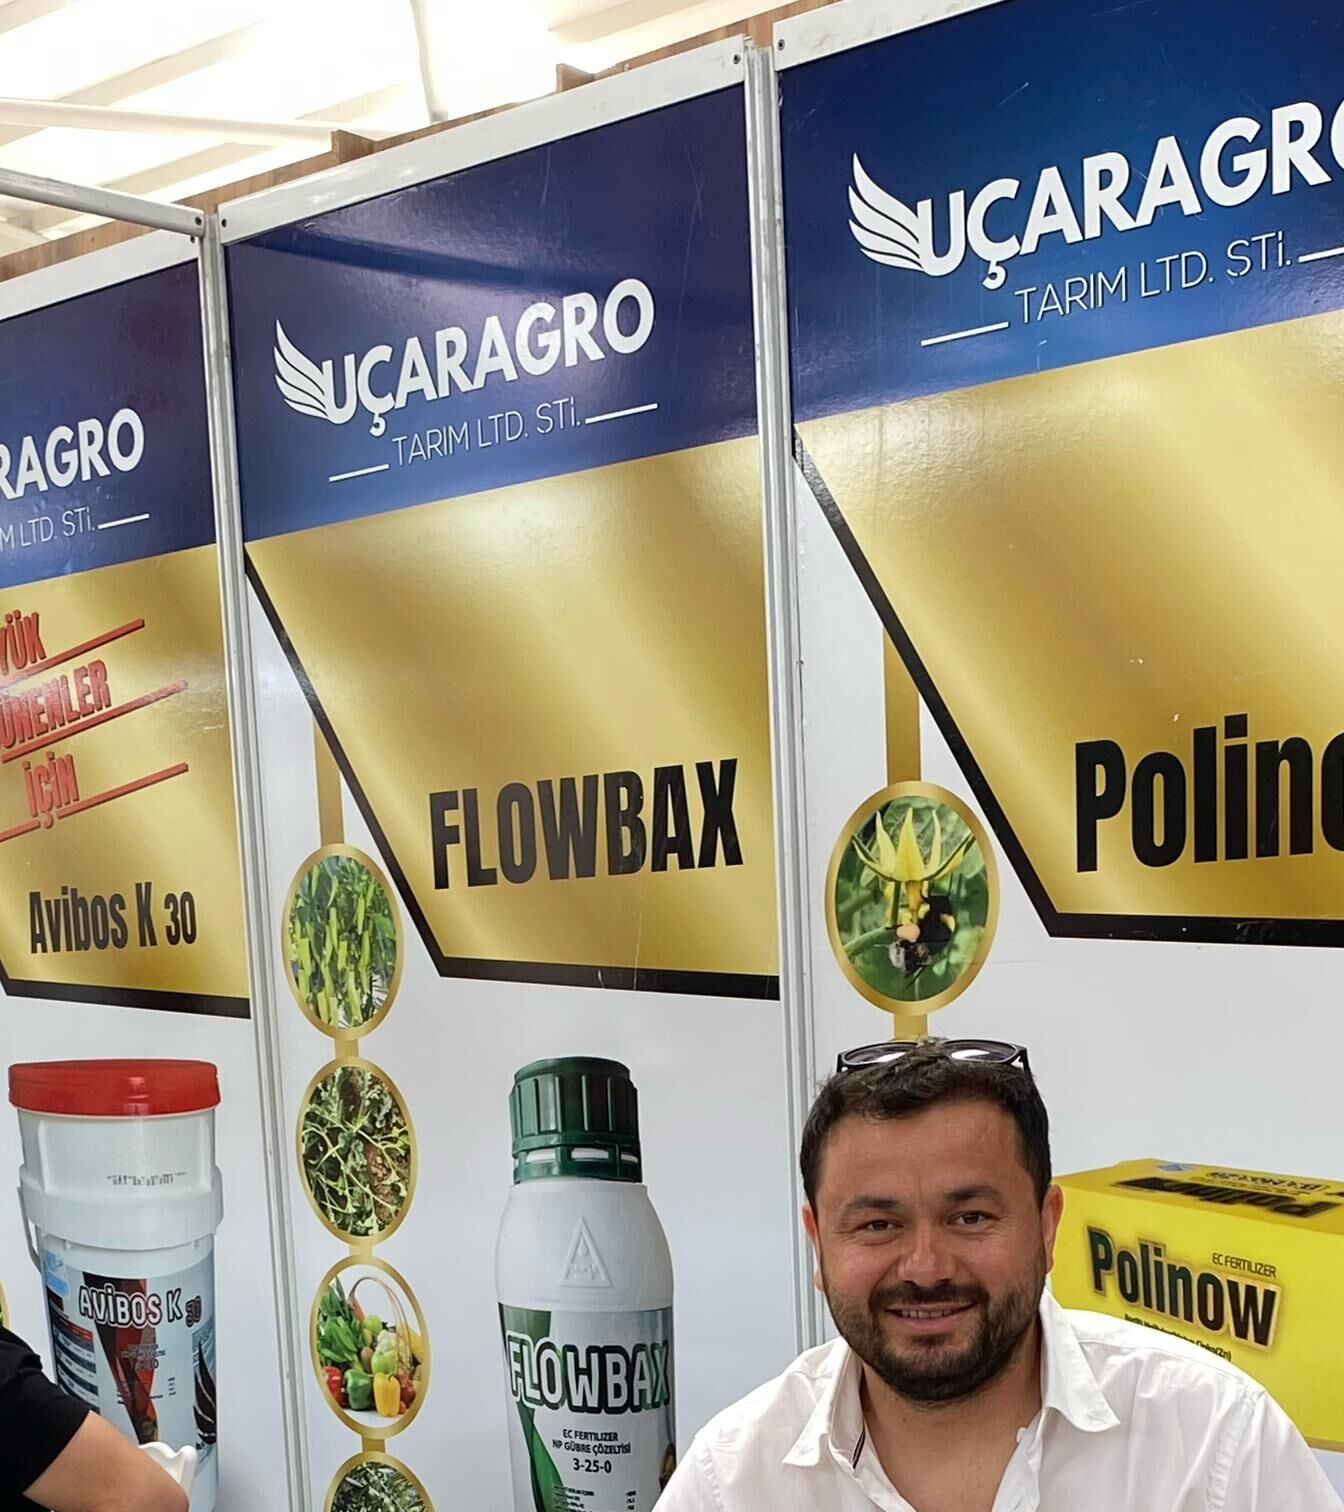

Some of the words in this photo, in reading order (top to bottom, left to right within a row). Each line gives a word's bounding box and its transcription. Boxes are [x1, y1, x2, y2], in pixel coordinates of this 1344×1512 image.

[1016, 270, 1129, 326] TARIM
[1140, 247, 1215, 303] LTD.
[320, 279, 655, 436] UÇARAGRO
[392, 424, 470, 467] TARIM
[477, 409, 529, 449] LTD.
[16, 516, 58, 552] LTD.
[23, 751, 80, 828] İÇİN
[429, 758, 744, 891] FLOWBAX
[29, 891, 128, 954] Avibos
[135, 881, 157, 947] K
[164, 891, 197, 946] 30
[1087, 1225, 1279, 1348] Polinow
[1212, 1252, 1224, 1265] EC
[1224, 1255, 1277, 1279] FERTILIZER
[79, 1285, 162, 1326] AVİBOS
[167, 1288, 182, 1322] K
[185, 1296, 202, 1327] 30
[508, 1334, 669, 1414] FLOWBAX
[563, 1429, 573, 1439] EC
[574, 1431, 619, 1442] FERTILIZER
[564, 1441, 591, 1454] GÜBRE
[573, 1458, 612, 1474] 3-25-0
